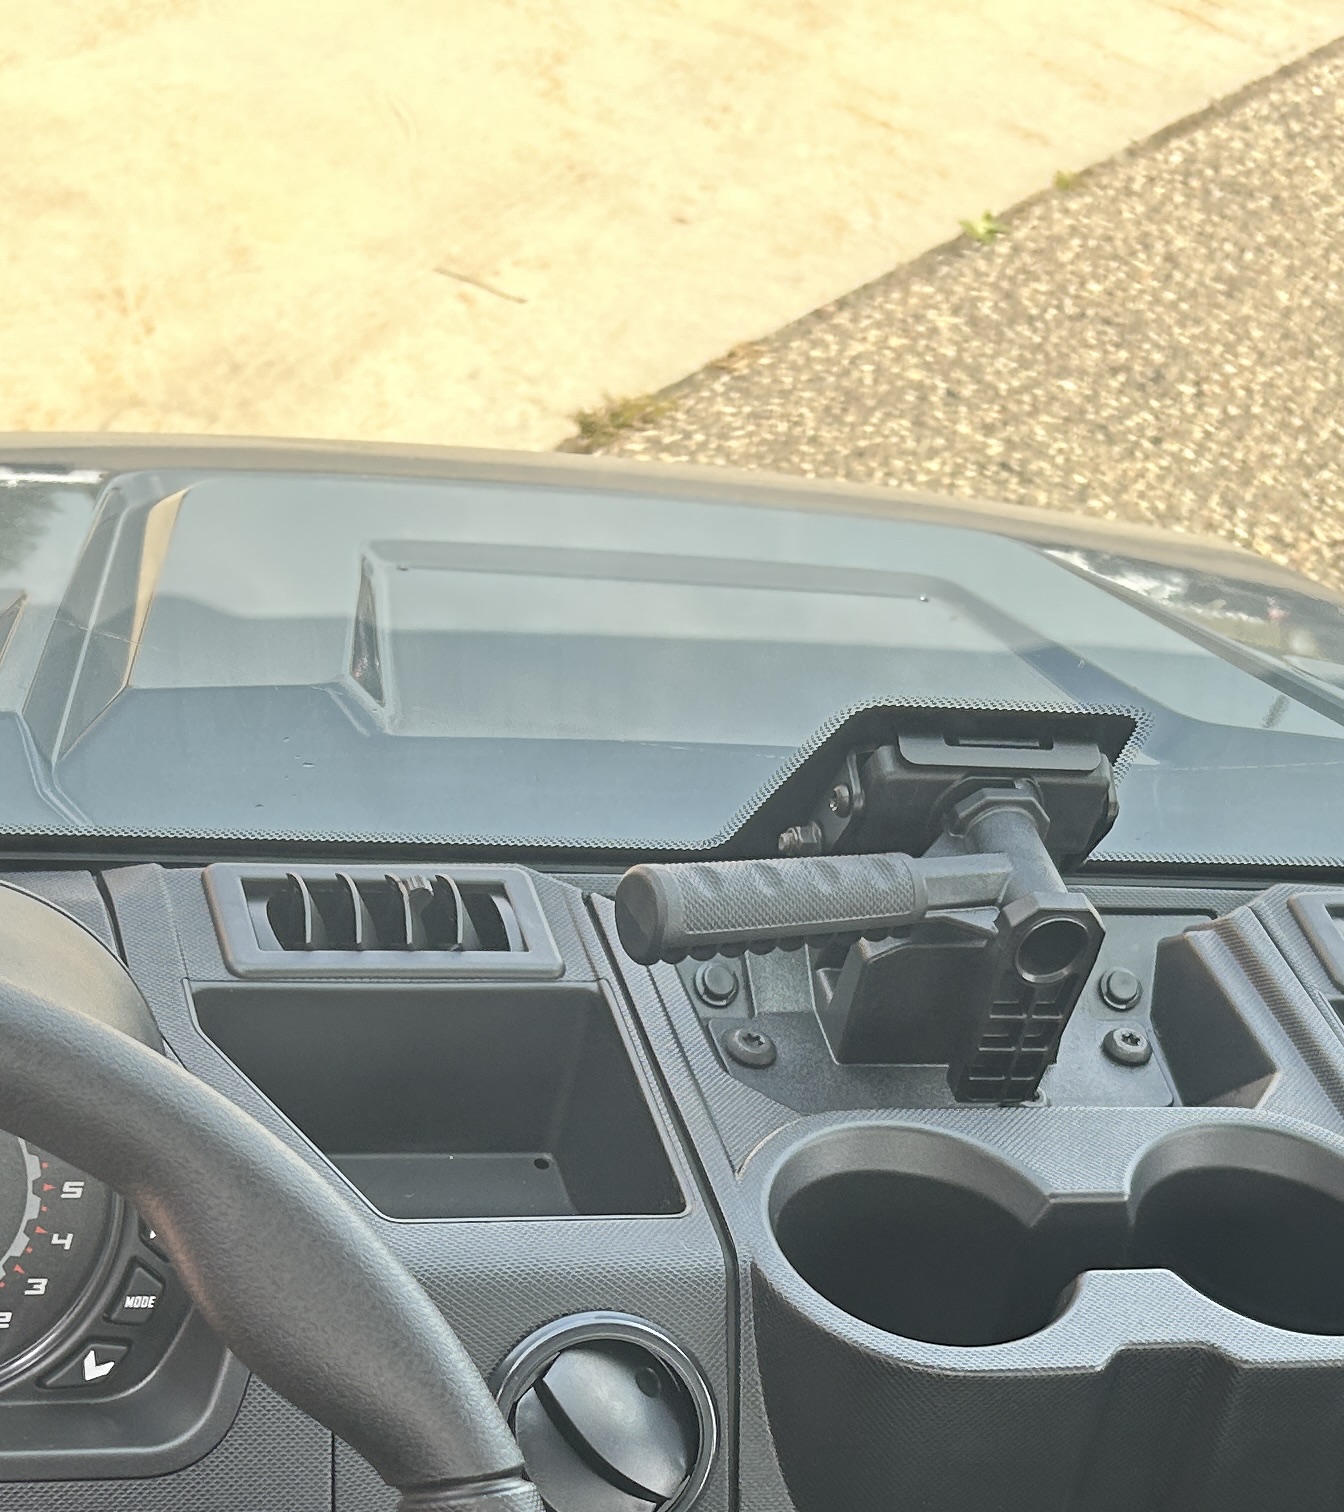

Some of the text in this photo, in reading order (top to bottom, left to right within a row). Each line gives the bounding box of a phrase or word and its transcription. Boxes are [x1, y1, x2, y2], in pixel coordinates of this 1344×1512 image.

[61, 1181, 84, 1199] 5
[51, 1233, 73, 1250] 4
[24, 1278, 48, 1295] 3
[124, 1295, 156, 1308] MODE
